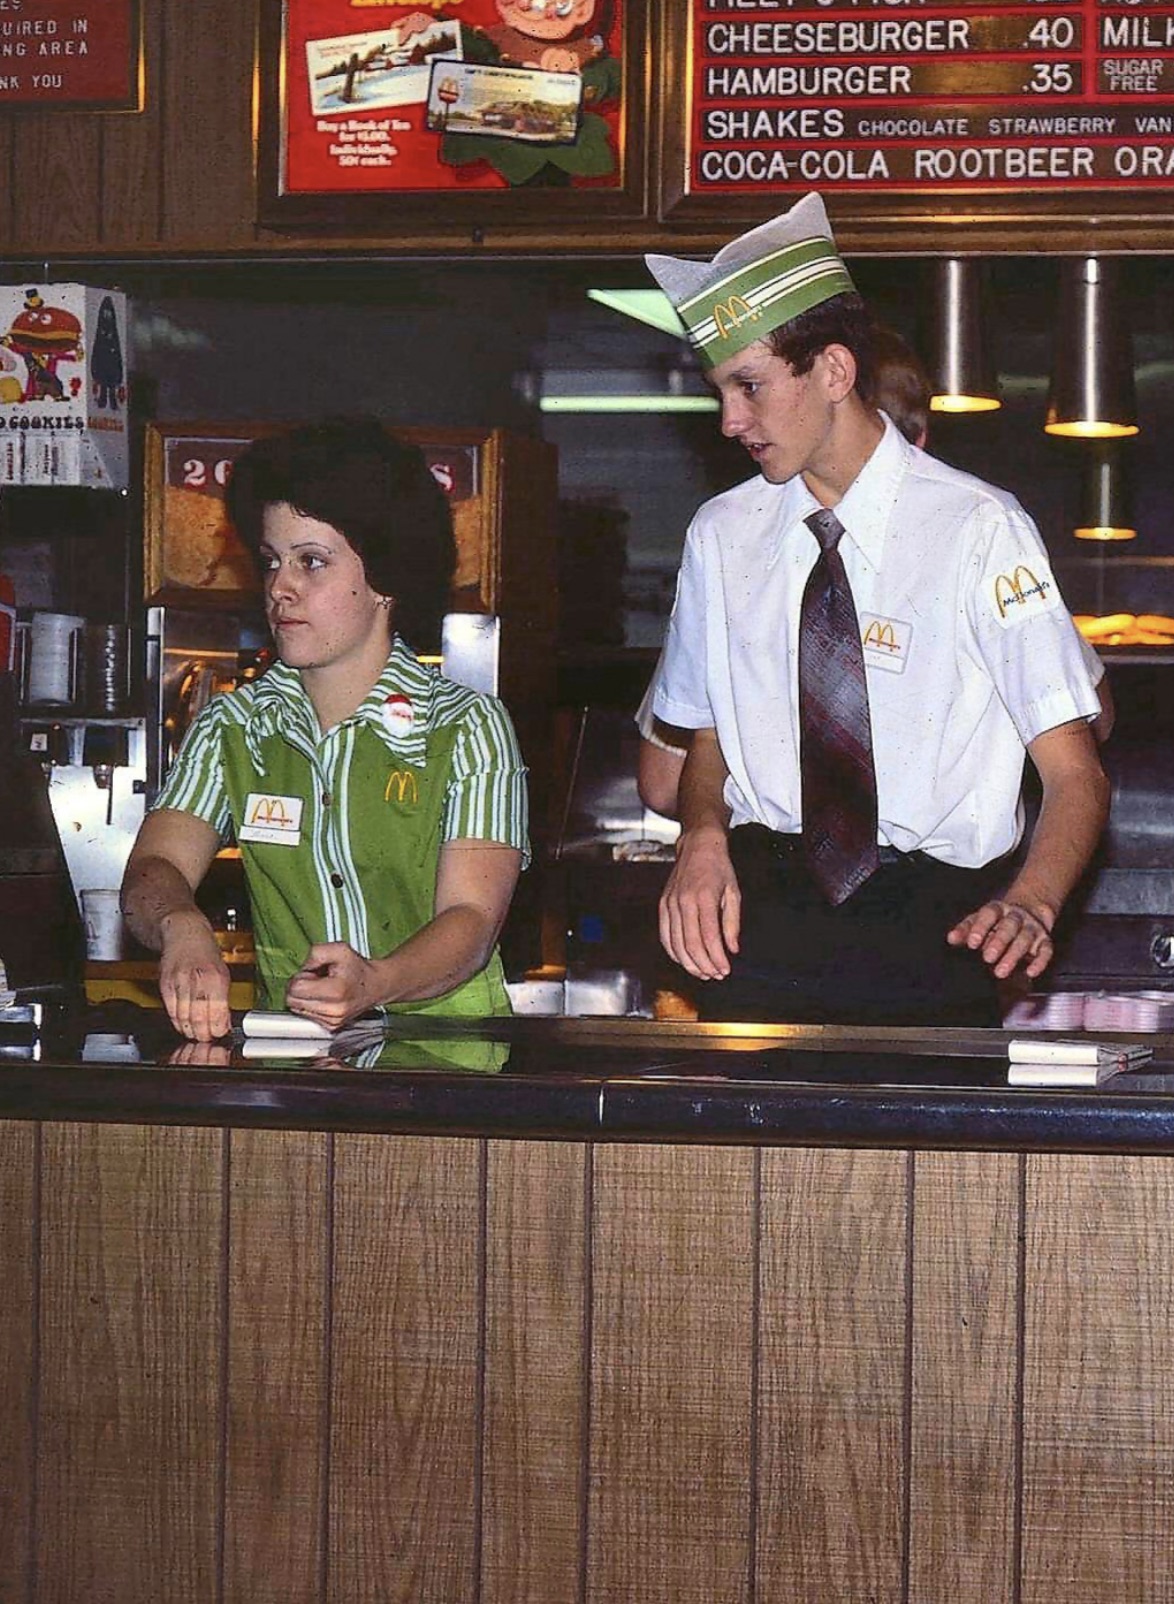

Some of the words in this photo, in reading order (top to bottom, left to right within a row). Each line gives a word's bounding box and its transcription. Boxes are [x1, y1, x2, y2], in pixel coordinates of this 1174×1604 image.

[73, 19, 88, 33] IN
[708, 19, 969, 53] CHEESEBURGER
[1023, 17, 1074, 48] .40
[39, 41, 88, 55] AREA
[1104, 60, 1163, 75] SUGAR
[32, 74, 62, 88] YOU
[708, 65, 911, 95] HAMBURGER
[1022, 63, 1073, 93] .35
[1110, 76, 1158, 92] FREE
[707, 108, 844, 139] SHAKES
[858, 118, 968, 136] CHOCOLATE
[988, 117, 1116, 135] STRAWBERRY
[702, 149, 890, 180] COCA-COLA
[915, 147, 1094, 178] ROOTBEER
